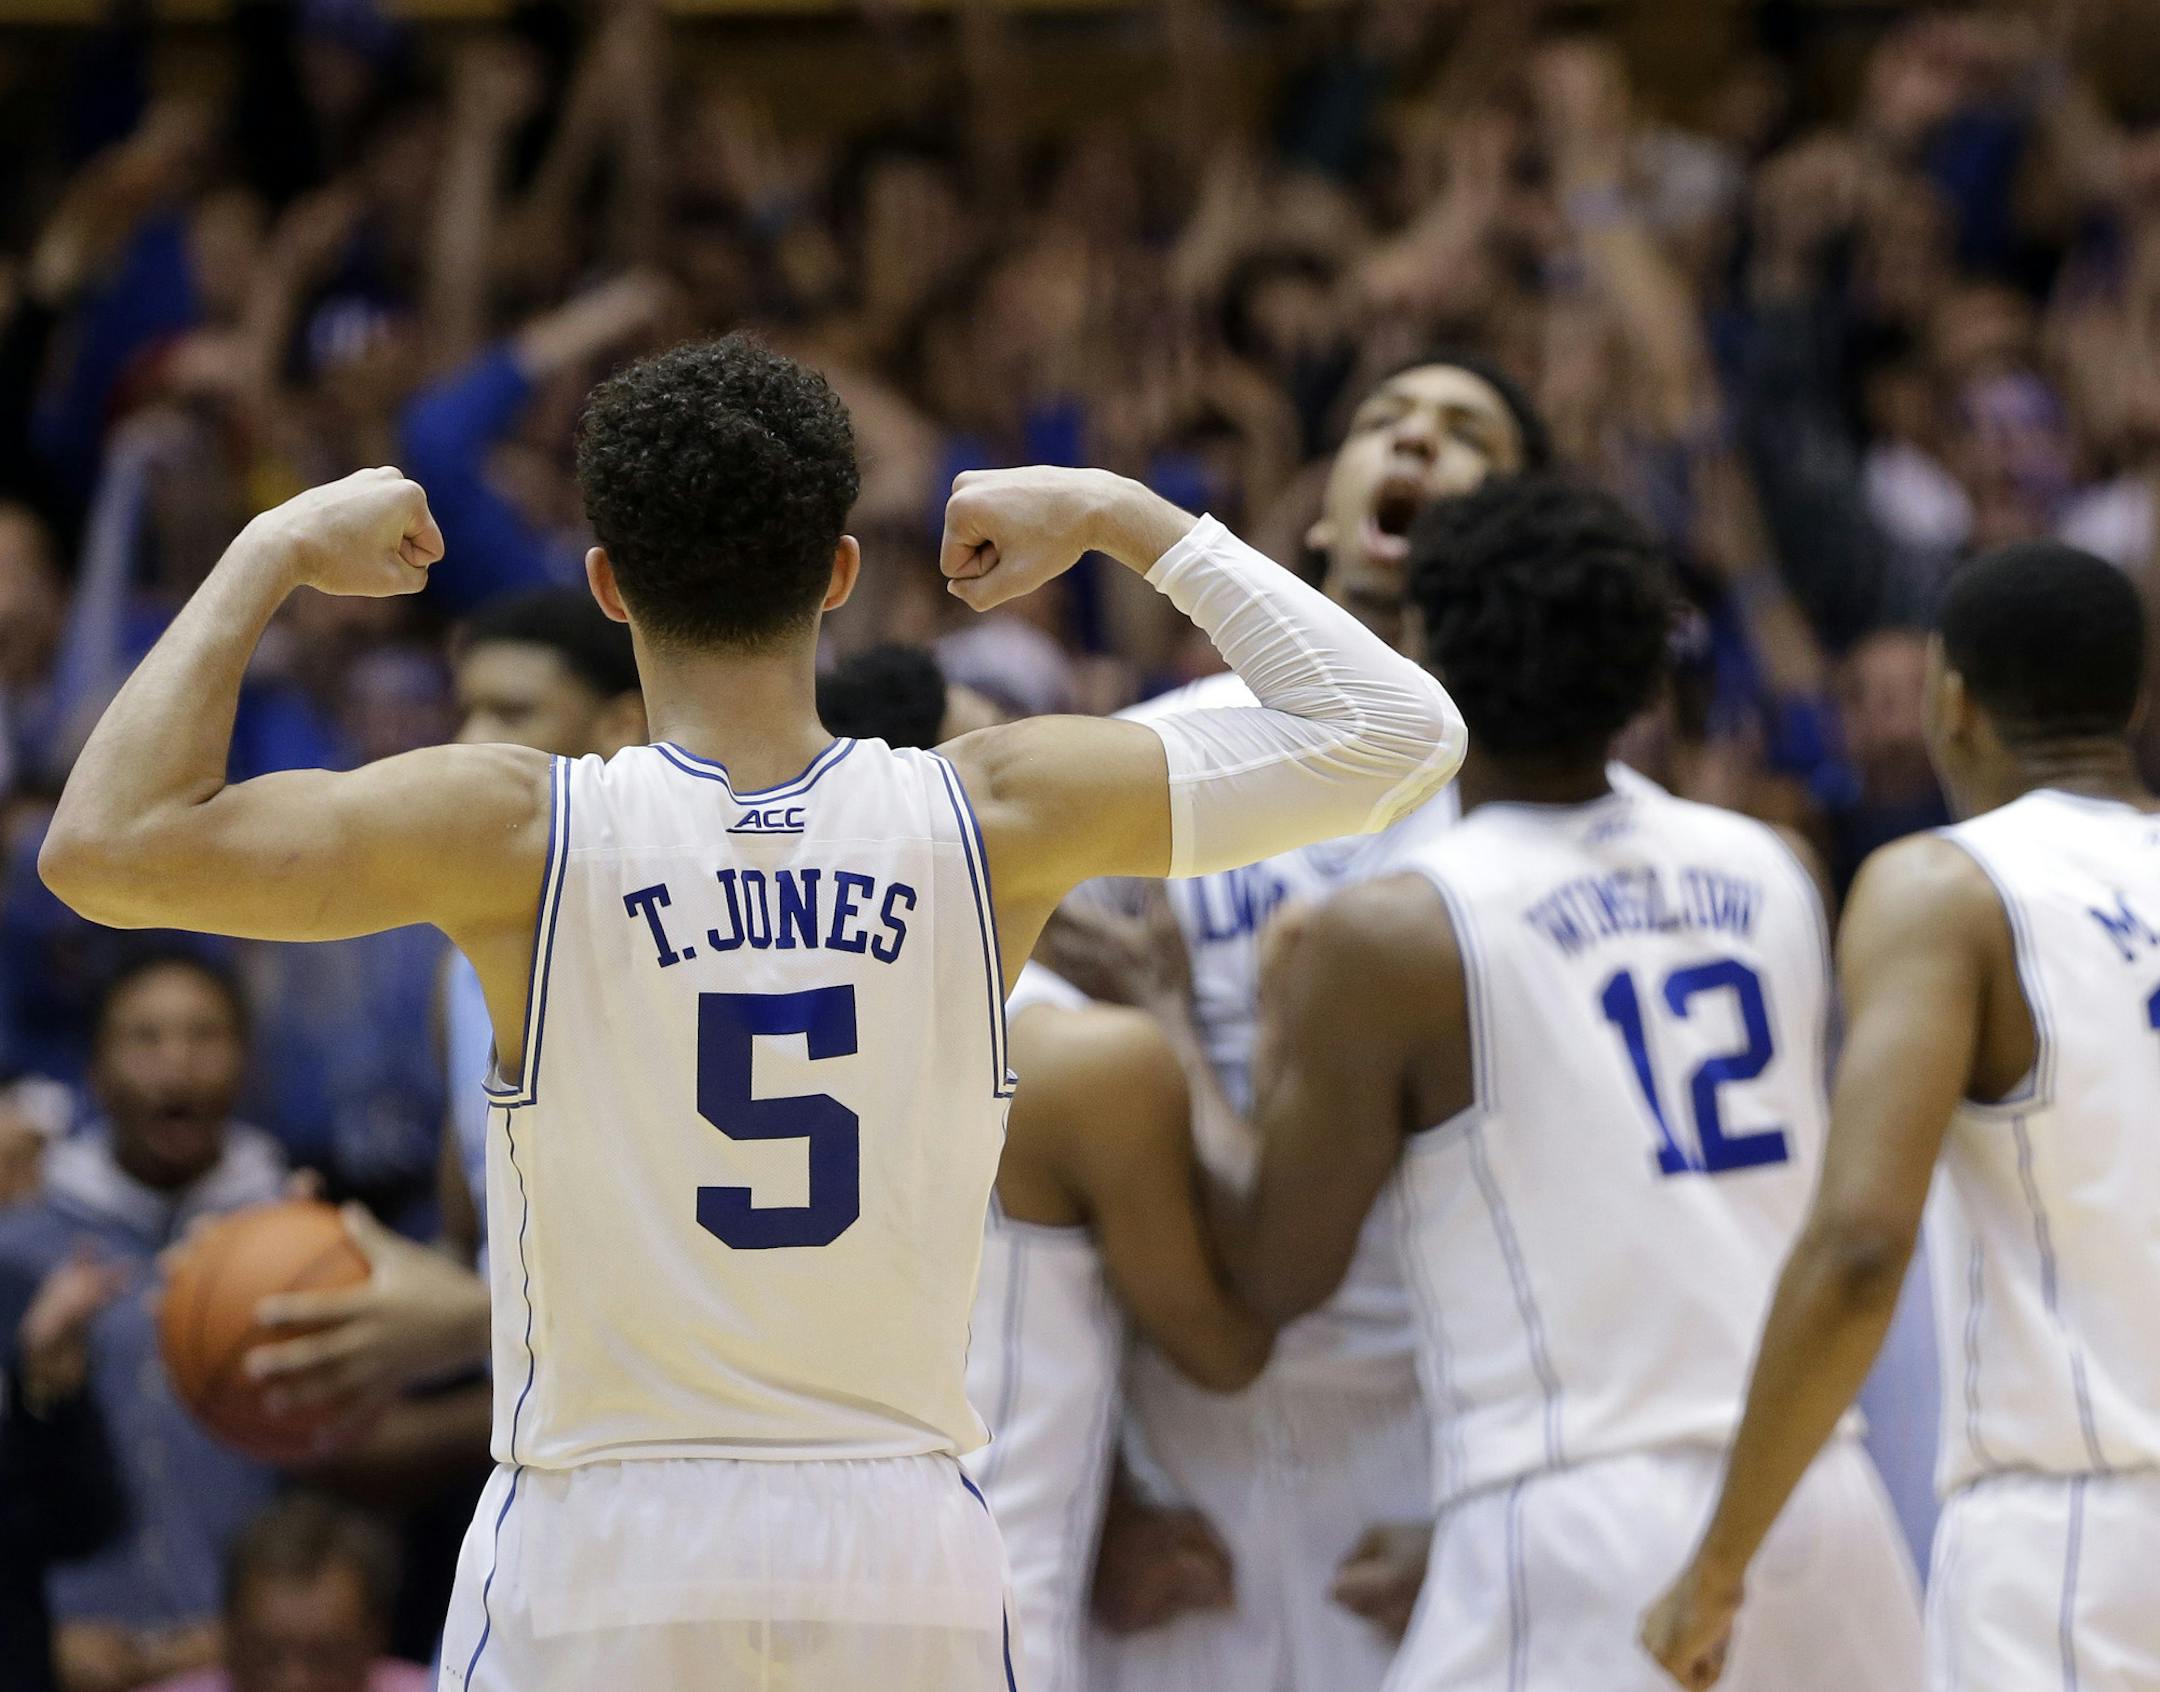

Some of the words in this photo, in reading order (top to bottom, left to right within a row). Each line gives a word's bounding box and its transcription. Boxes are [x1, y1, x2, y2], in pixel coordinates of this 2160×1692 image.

[734, 807, 806, 828] ACC
[696, 984, 860, 1250] 5
[1600, 958, 1789, 1175] 12
